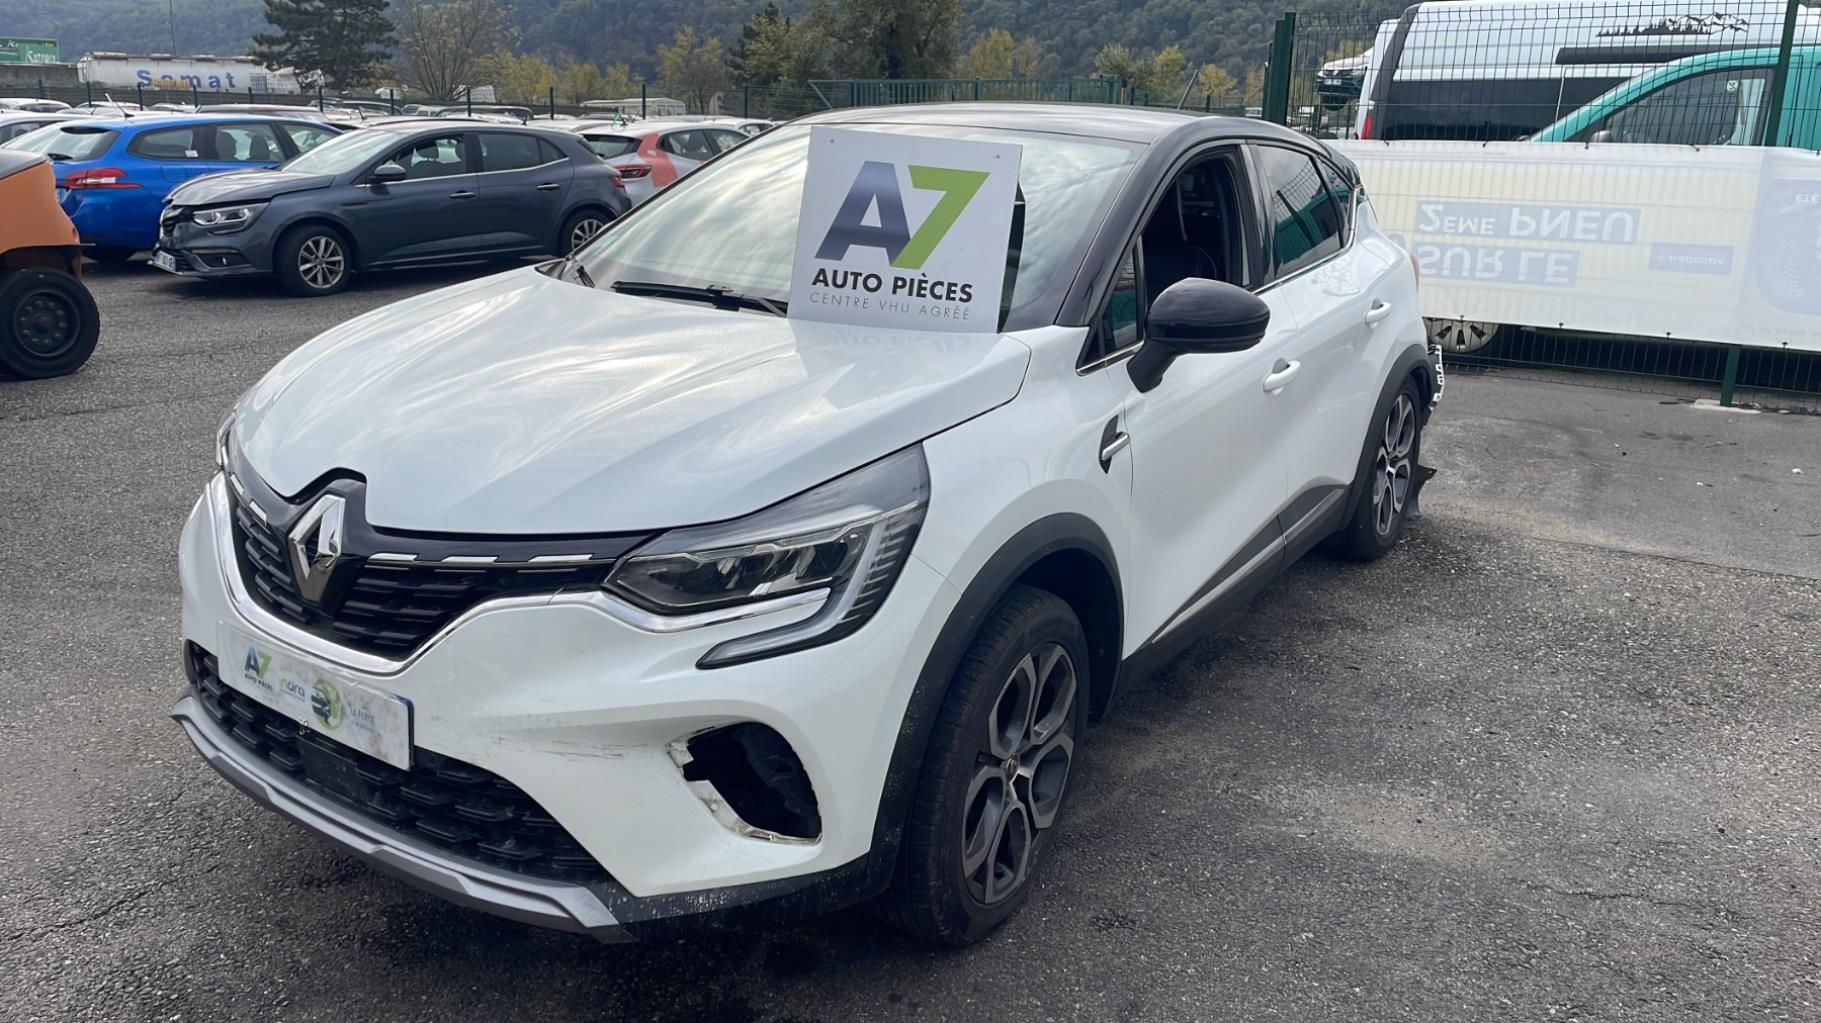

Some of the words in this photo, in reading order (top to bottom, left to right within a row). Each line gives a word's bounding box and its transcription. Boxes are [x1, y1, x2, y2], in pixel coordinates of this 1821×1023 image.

[814, 160, 991, 270] A7
[811, 268, 883, 293] AUTO
[892, 273, 974, 304] PIÈCES
[809, 291, 870, 310] CENTRE
[879, 299, 911, 314] VHU
[919, 305, 970, 321] AGRÉÉ
[244, 646, 272, 679] A7
